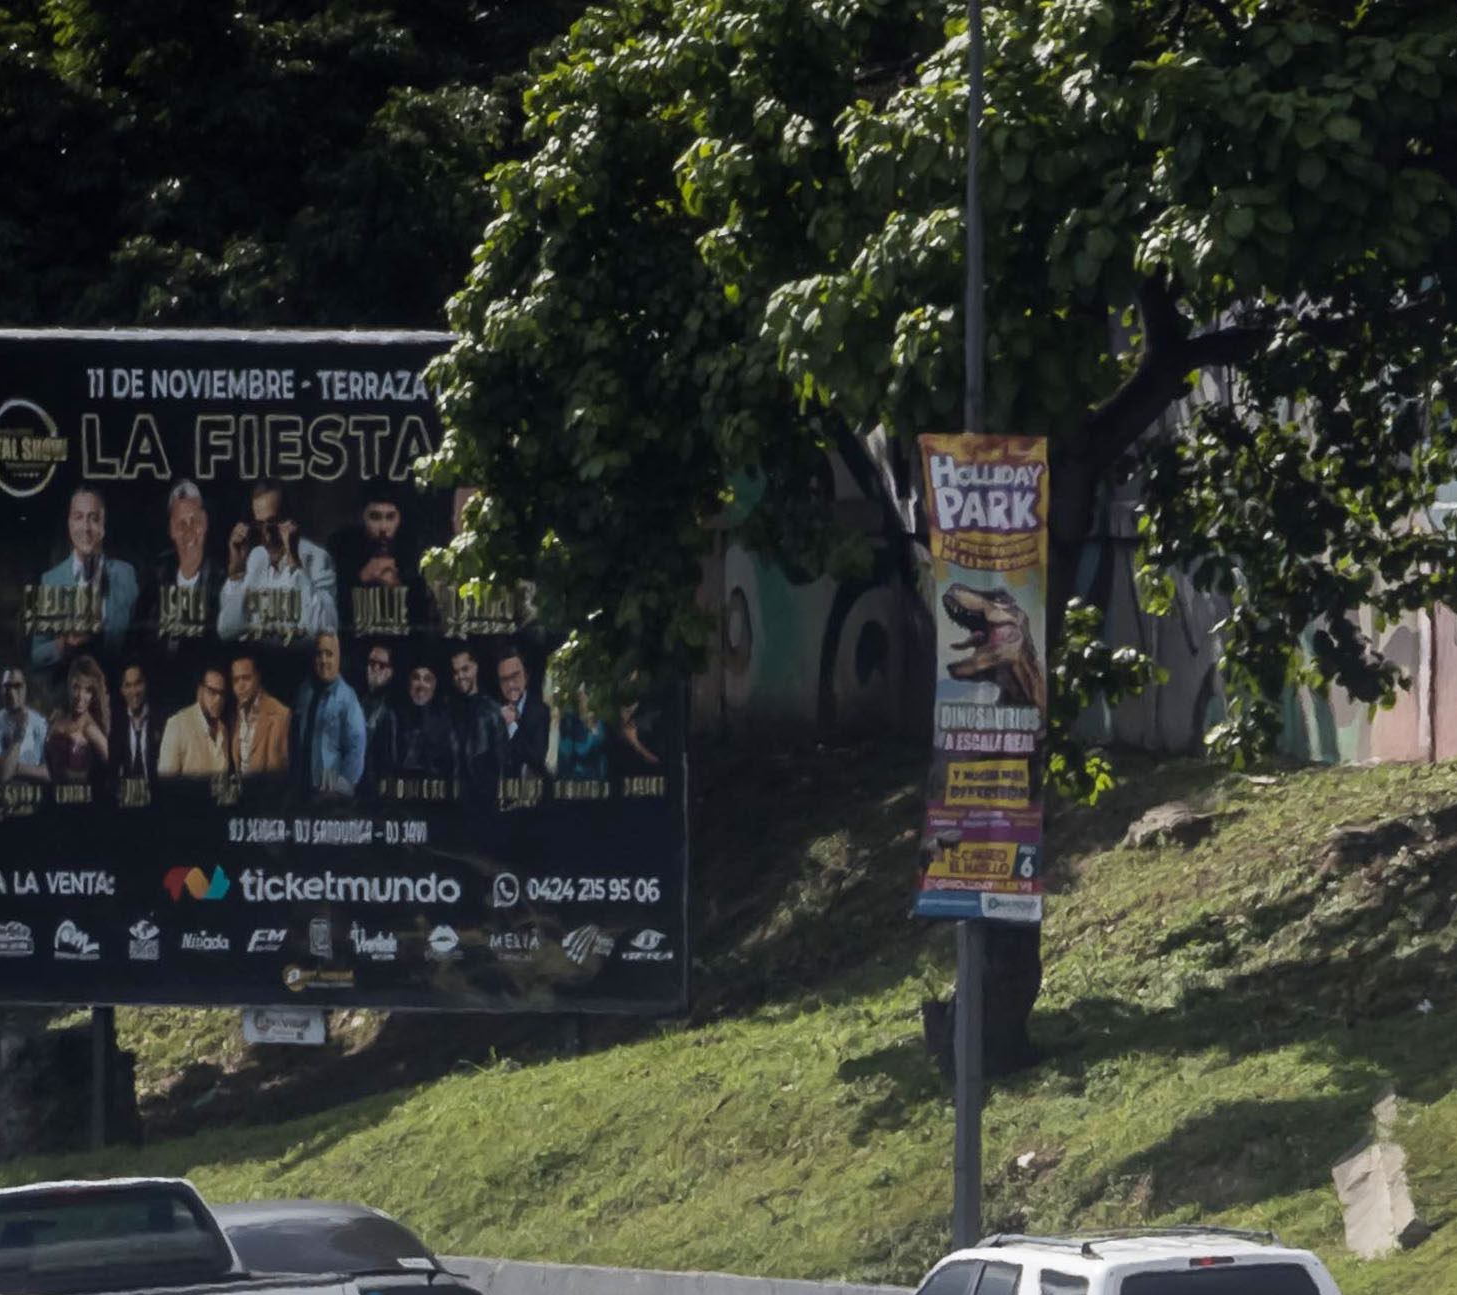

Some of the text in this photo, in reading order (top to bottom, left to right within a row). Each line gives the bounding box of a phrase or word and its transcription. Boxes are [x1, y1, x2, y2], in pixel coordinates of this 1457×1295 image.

[86, 369, 105, 398] 11
[112, 369, 145, 398] DE
[151, 369, 296, 399] NOVIEMBRE
[316, 370, 429, 401] TERRAZA
[21, 433, 69, 461] SHOW
[81, 413, 434, 481] LA FIESTA
[929, 455, 1043, 489] HOLLIDAY
[934, 486, 1039, 530] PARK
[386, 820, 400, 844] DJ
[1020, 856, 1034, 879] 6
[13, 871, 40, 895] LA
[45, 870, 116, 896] VENTA:
[239, 868, 461, 903] ticketmundo
[526, 877, 661, 903] 0424 215 95 06
